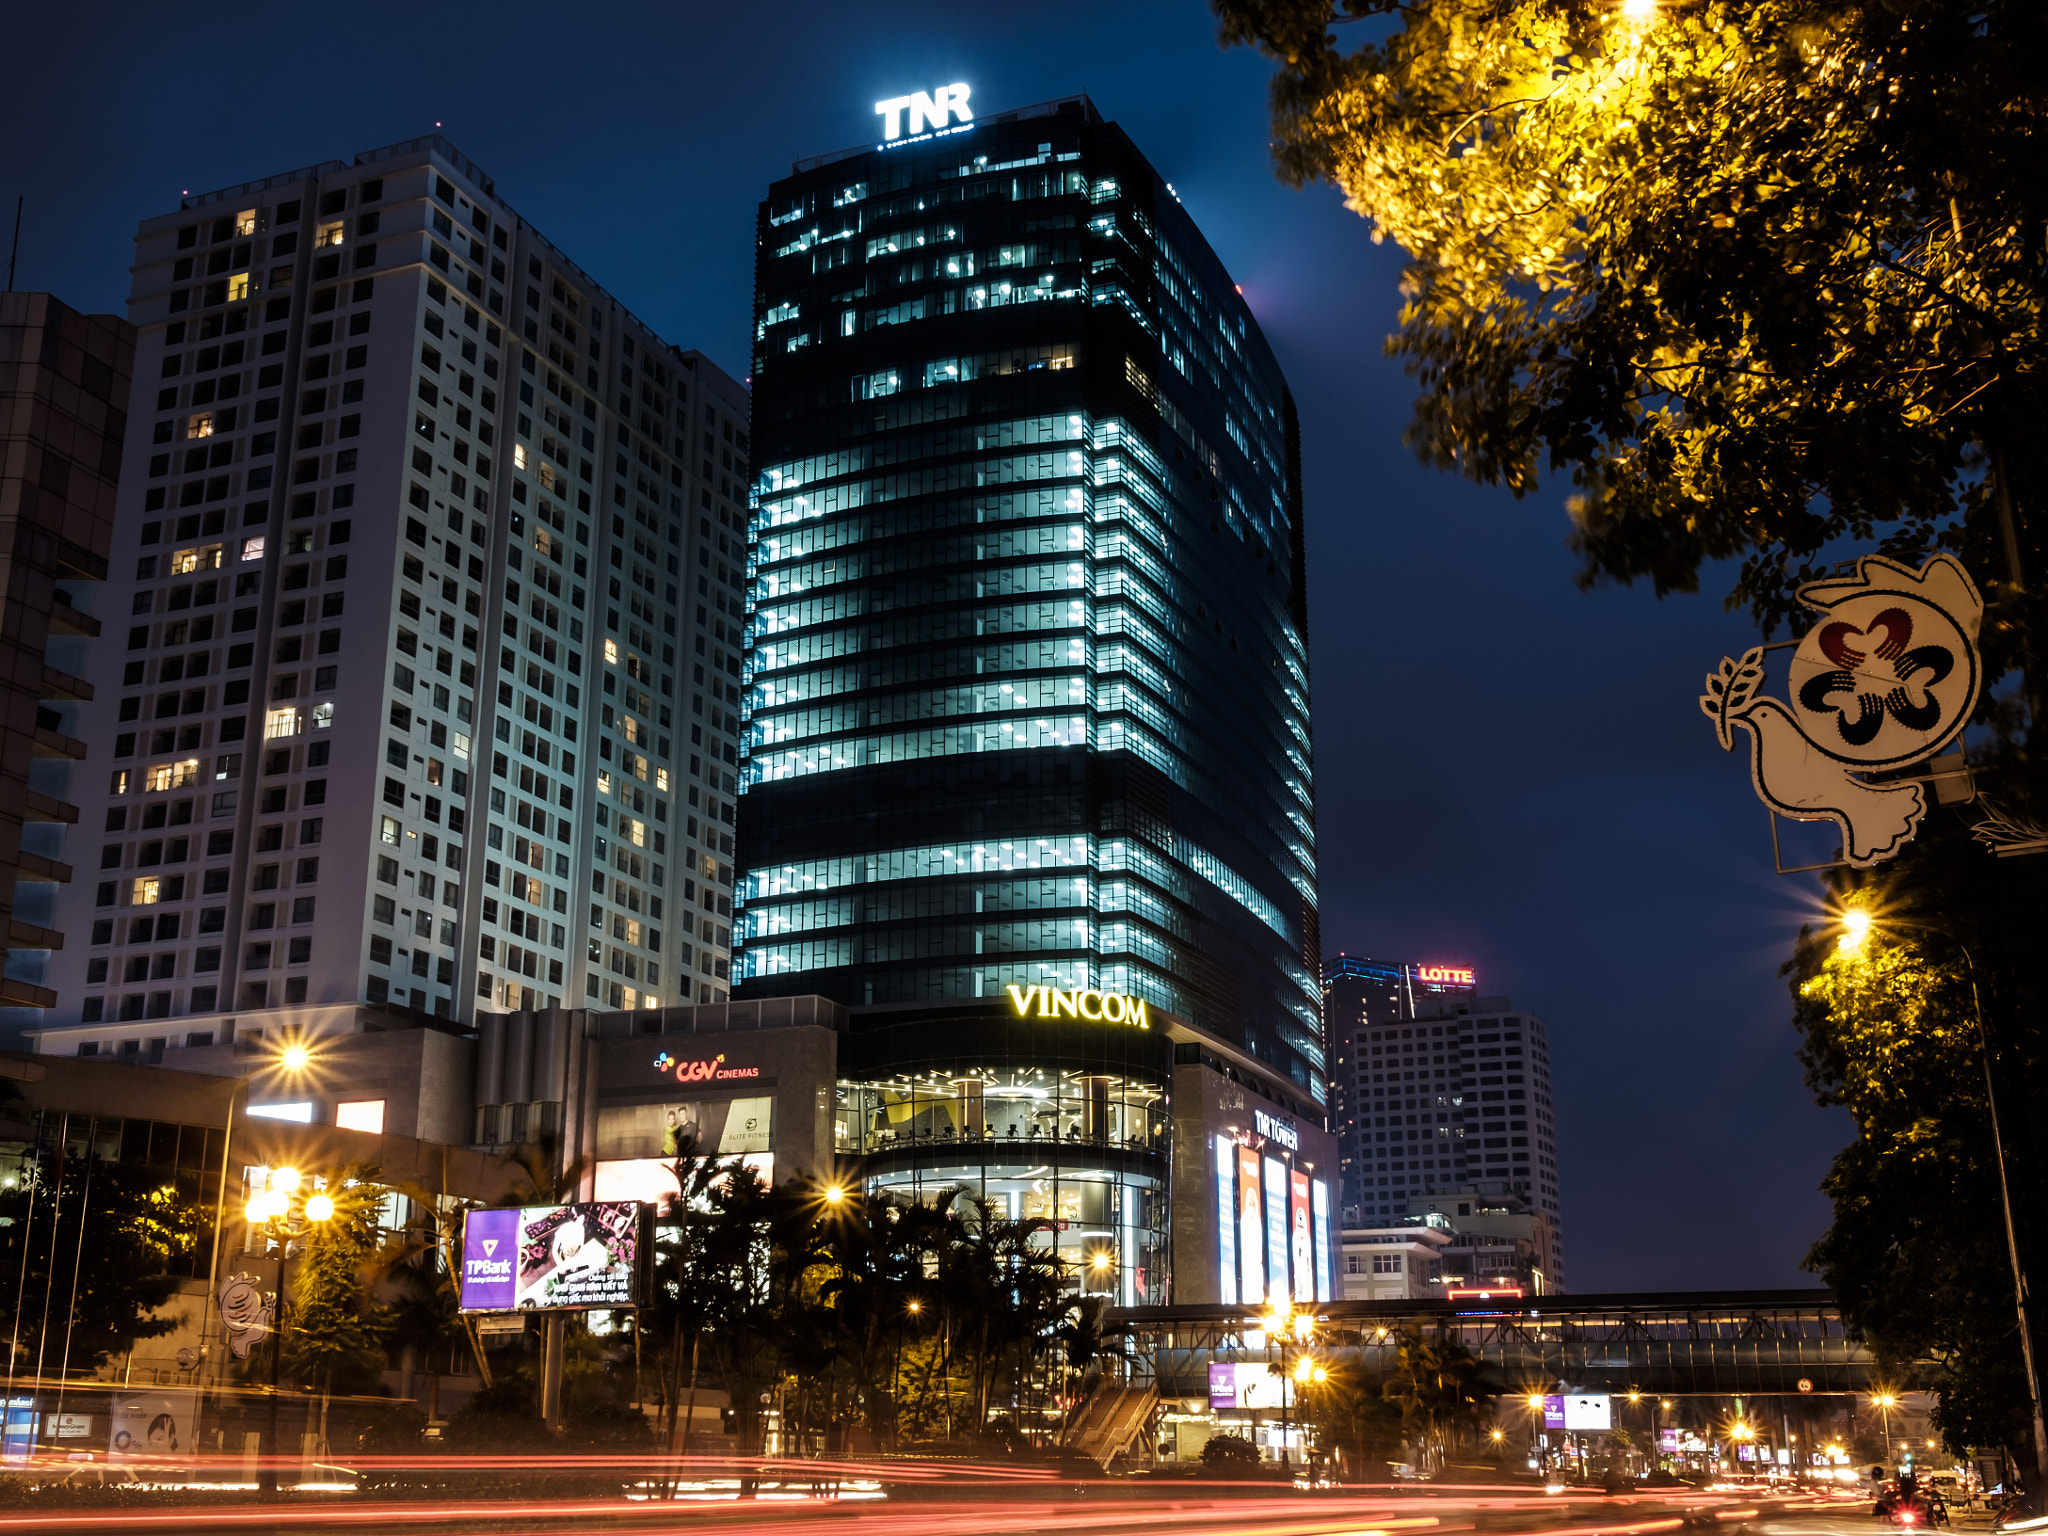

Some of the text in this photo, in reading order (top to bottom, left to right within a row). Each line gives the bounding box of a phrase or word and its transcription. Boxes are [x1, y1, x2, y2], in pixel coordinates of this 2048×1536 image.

[875, 82, 974, 141] TNR
[1420, 967, 1473, 983] LOTTE
[1006, 984, 1150, 1029] VINCOM
[676, 1060, 718, 1082] CGV
[716, 1067, 759, 1080] CINEMAS
[728, 1131, 775, 1141] ELITE FITNESS
[1254, 1109, 1271, 1138] TNR
[1270, 1117, 1298, 1151] TOWER
[466, 1258, 512, 1275] TPBank
